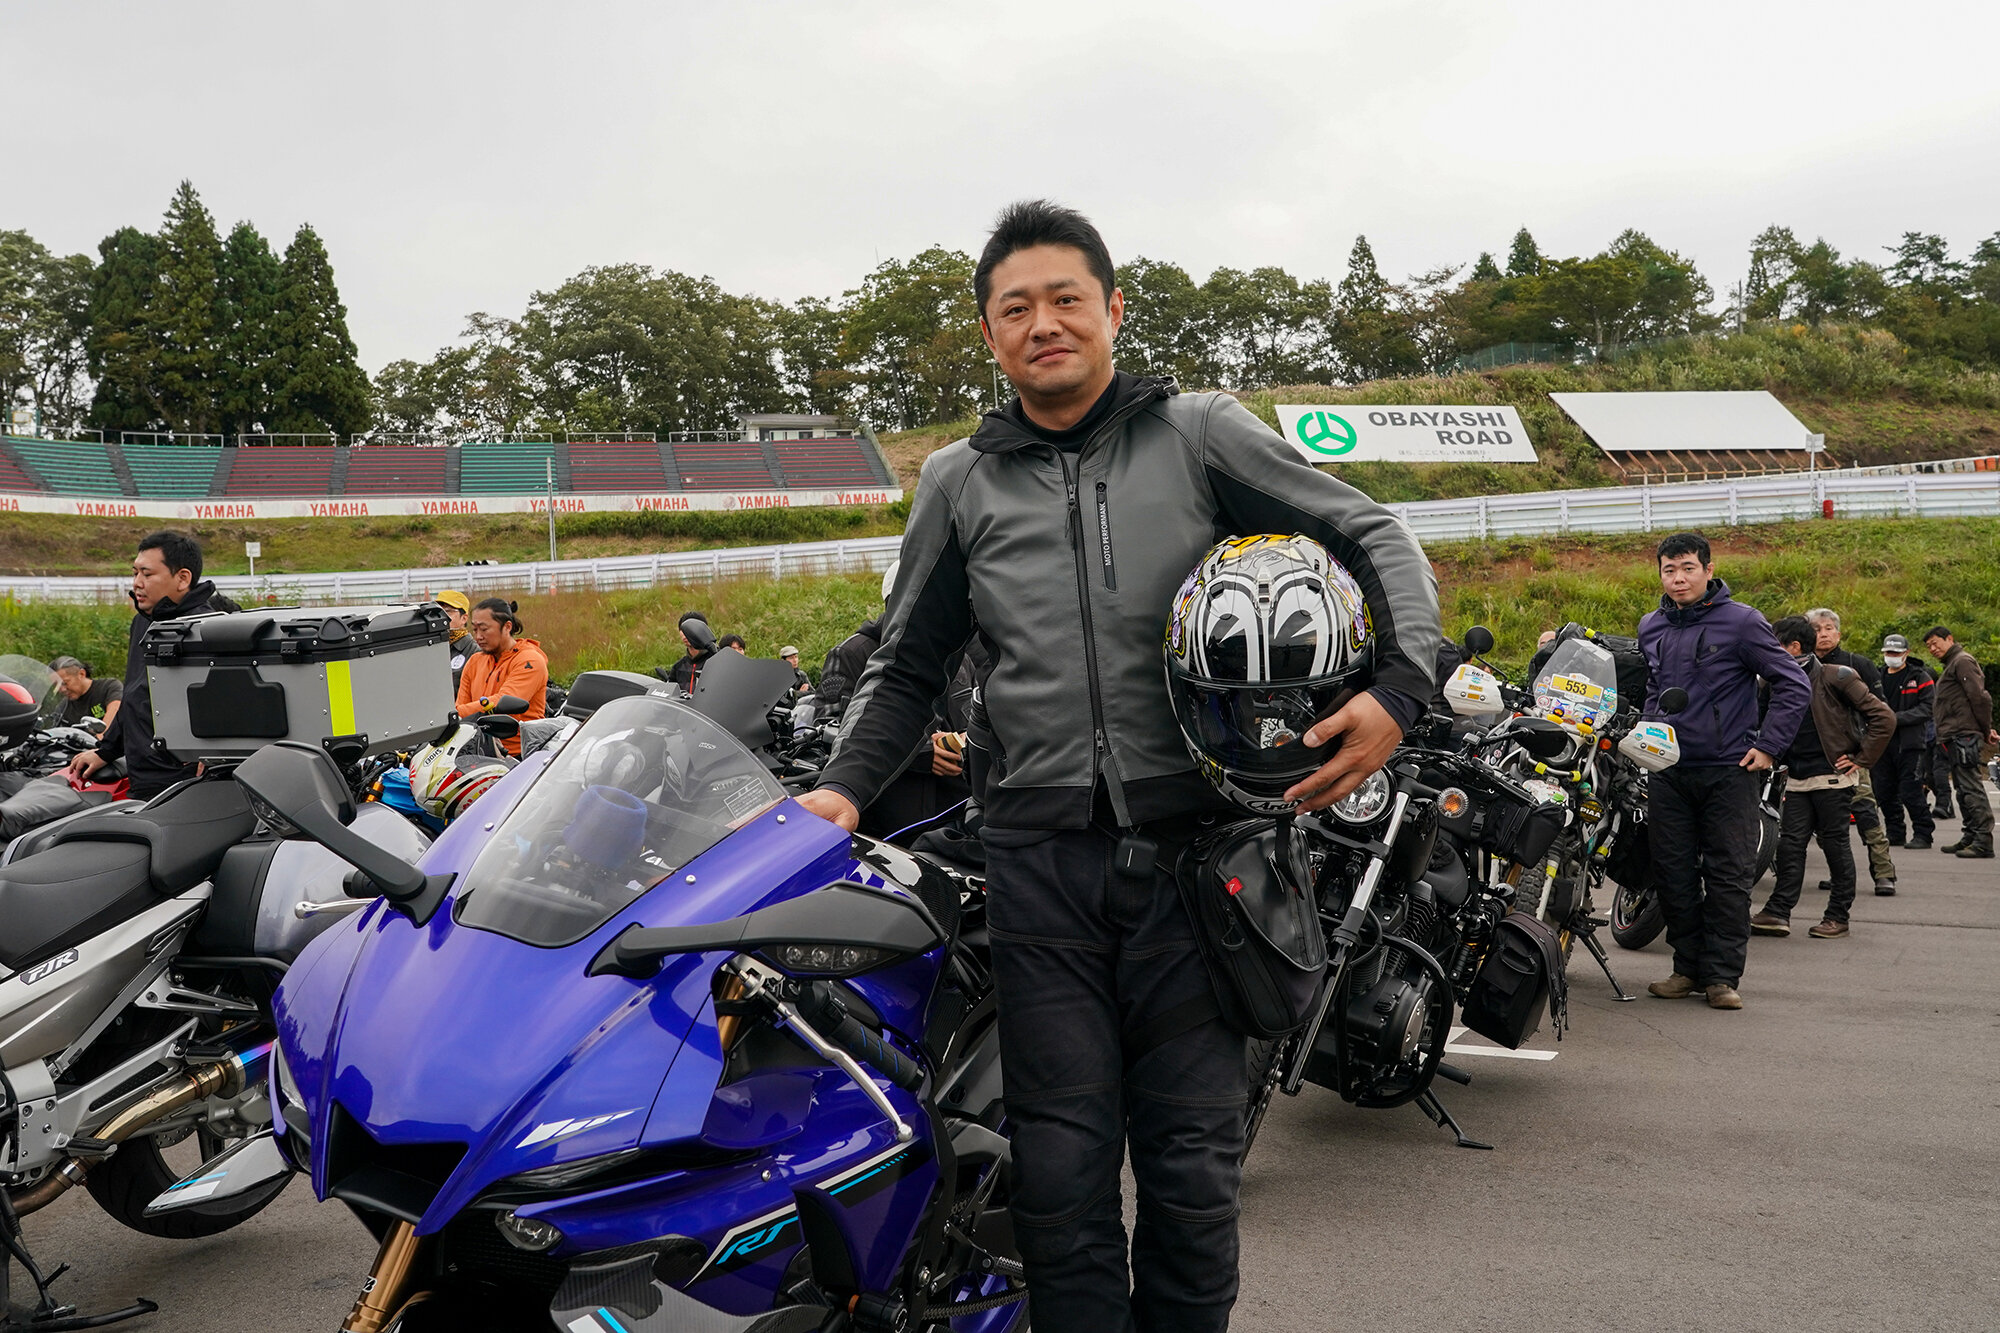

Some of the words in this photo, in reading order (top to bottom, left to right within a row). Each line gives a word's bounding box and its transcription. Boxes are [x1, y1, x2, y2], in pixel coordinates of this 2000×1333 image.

[1368, 411, 1506, 427] OBAYASHI
[1438, 430, 1513, 445] ROAD
[635, 497, 689, 511] YAMAHA
[738, 495, 790, 508] YAMAHA
[837, 493, 888, 505] YAMAHA
[76, 503, 137, 517] YAMAHA
[195, 504, 255, 518] YAMAHA
[310, 502, 369, 517] YAMAHA
[421, 500, 479, 515] YAMAHA
[1103, 544, 1112, 566] MOTO
[1565, 680, 1588, 696] 553
[424, 747, 443, 765] SHOEI
[1580, 806, 1601, 818] PIAA
[28, 951, 74, 983] FJR
[716, 1215, 799, 1265] R1
